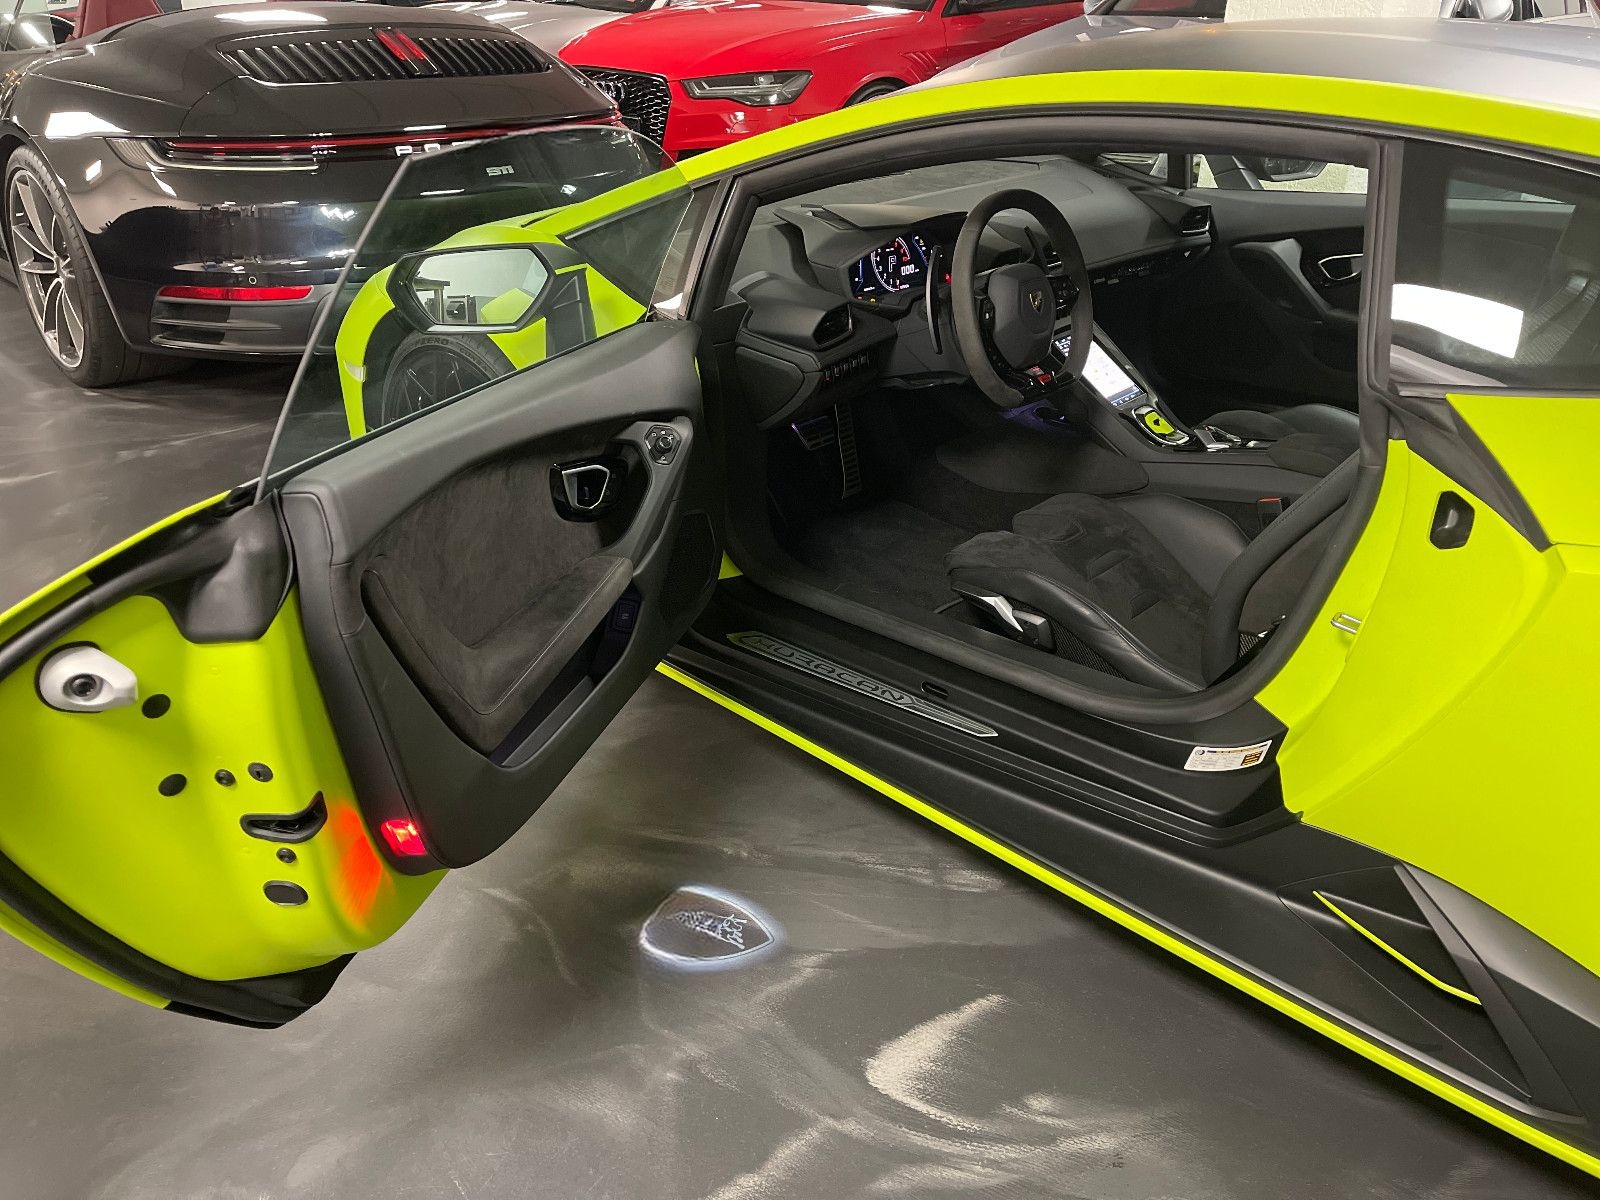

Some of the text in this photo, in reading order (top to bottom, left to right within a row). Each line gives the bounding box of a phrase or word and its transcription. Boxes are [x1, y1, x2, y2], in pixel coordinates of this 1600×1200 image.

[486, 165, 515, 176] 911
[888, 254, 896, 272] P
[900, 264, 915, 276] 000
